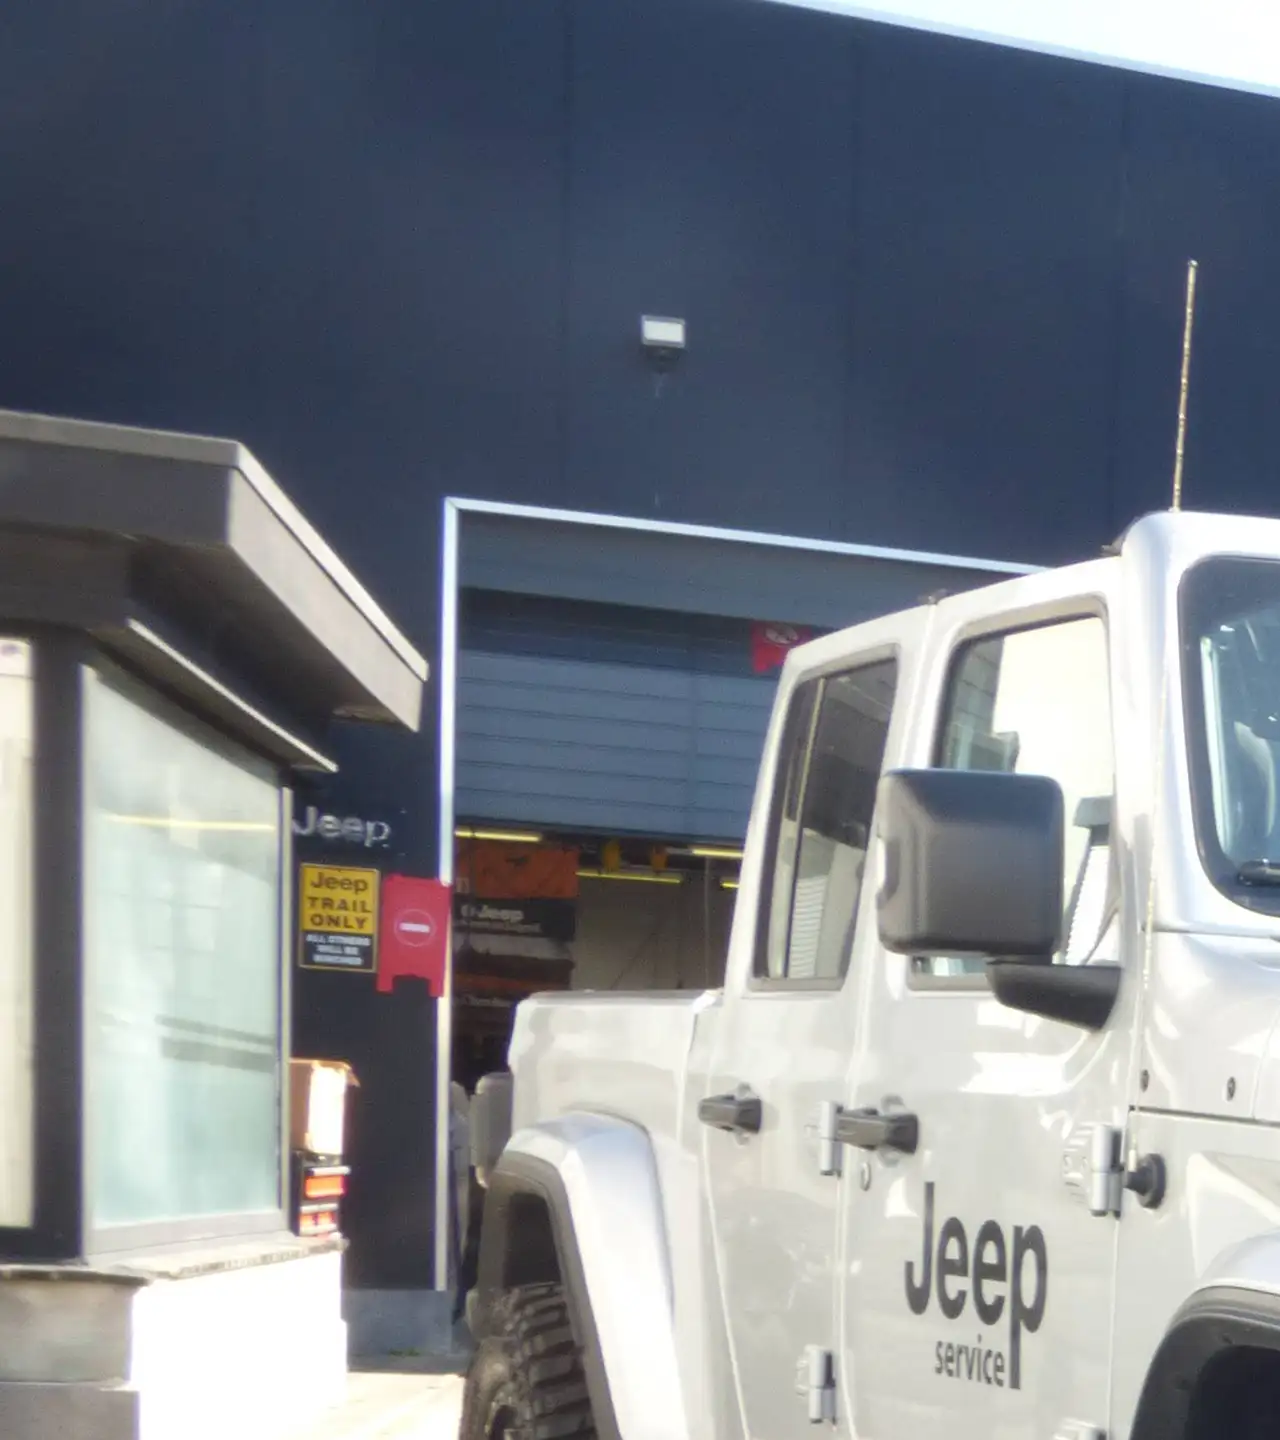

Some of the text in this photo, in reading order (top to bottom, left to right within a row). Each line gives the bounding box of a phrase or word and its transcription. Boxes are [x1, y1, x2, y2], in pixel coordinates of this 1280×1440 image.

[290, 805, 392, 848] Jeep
[310, 871, 369, 895] Jeep
[306, 896, 373, 914] TRAIL
[309, 913, 368, 930] ONLY
[904, 1181, 1048, 1390] Jeep
[935, 1333, 1006, 1388] service
